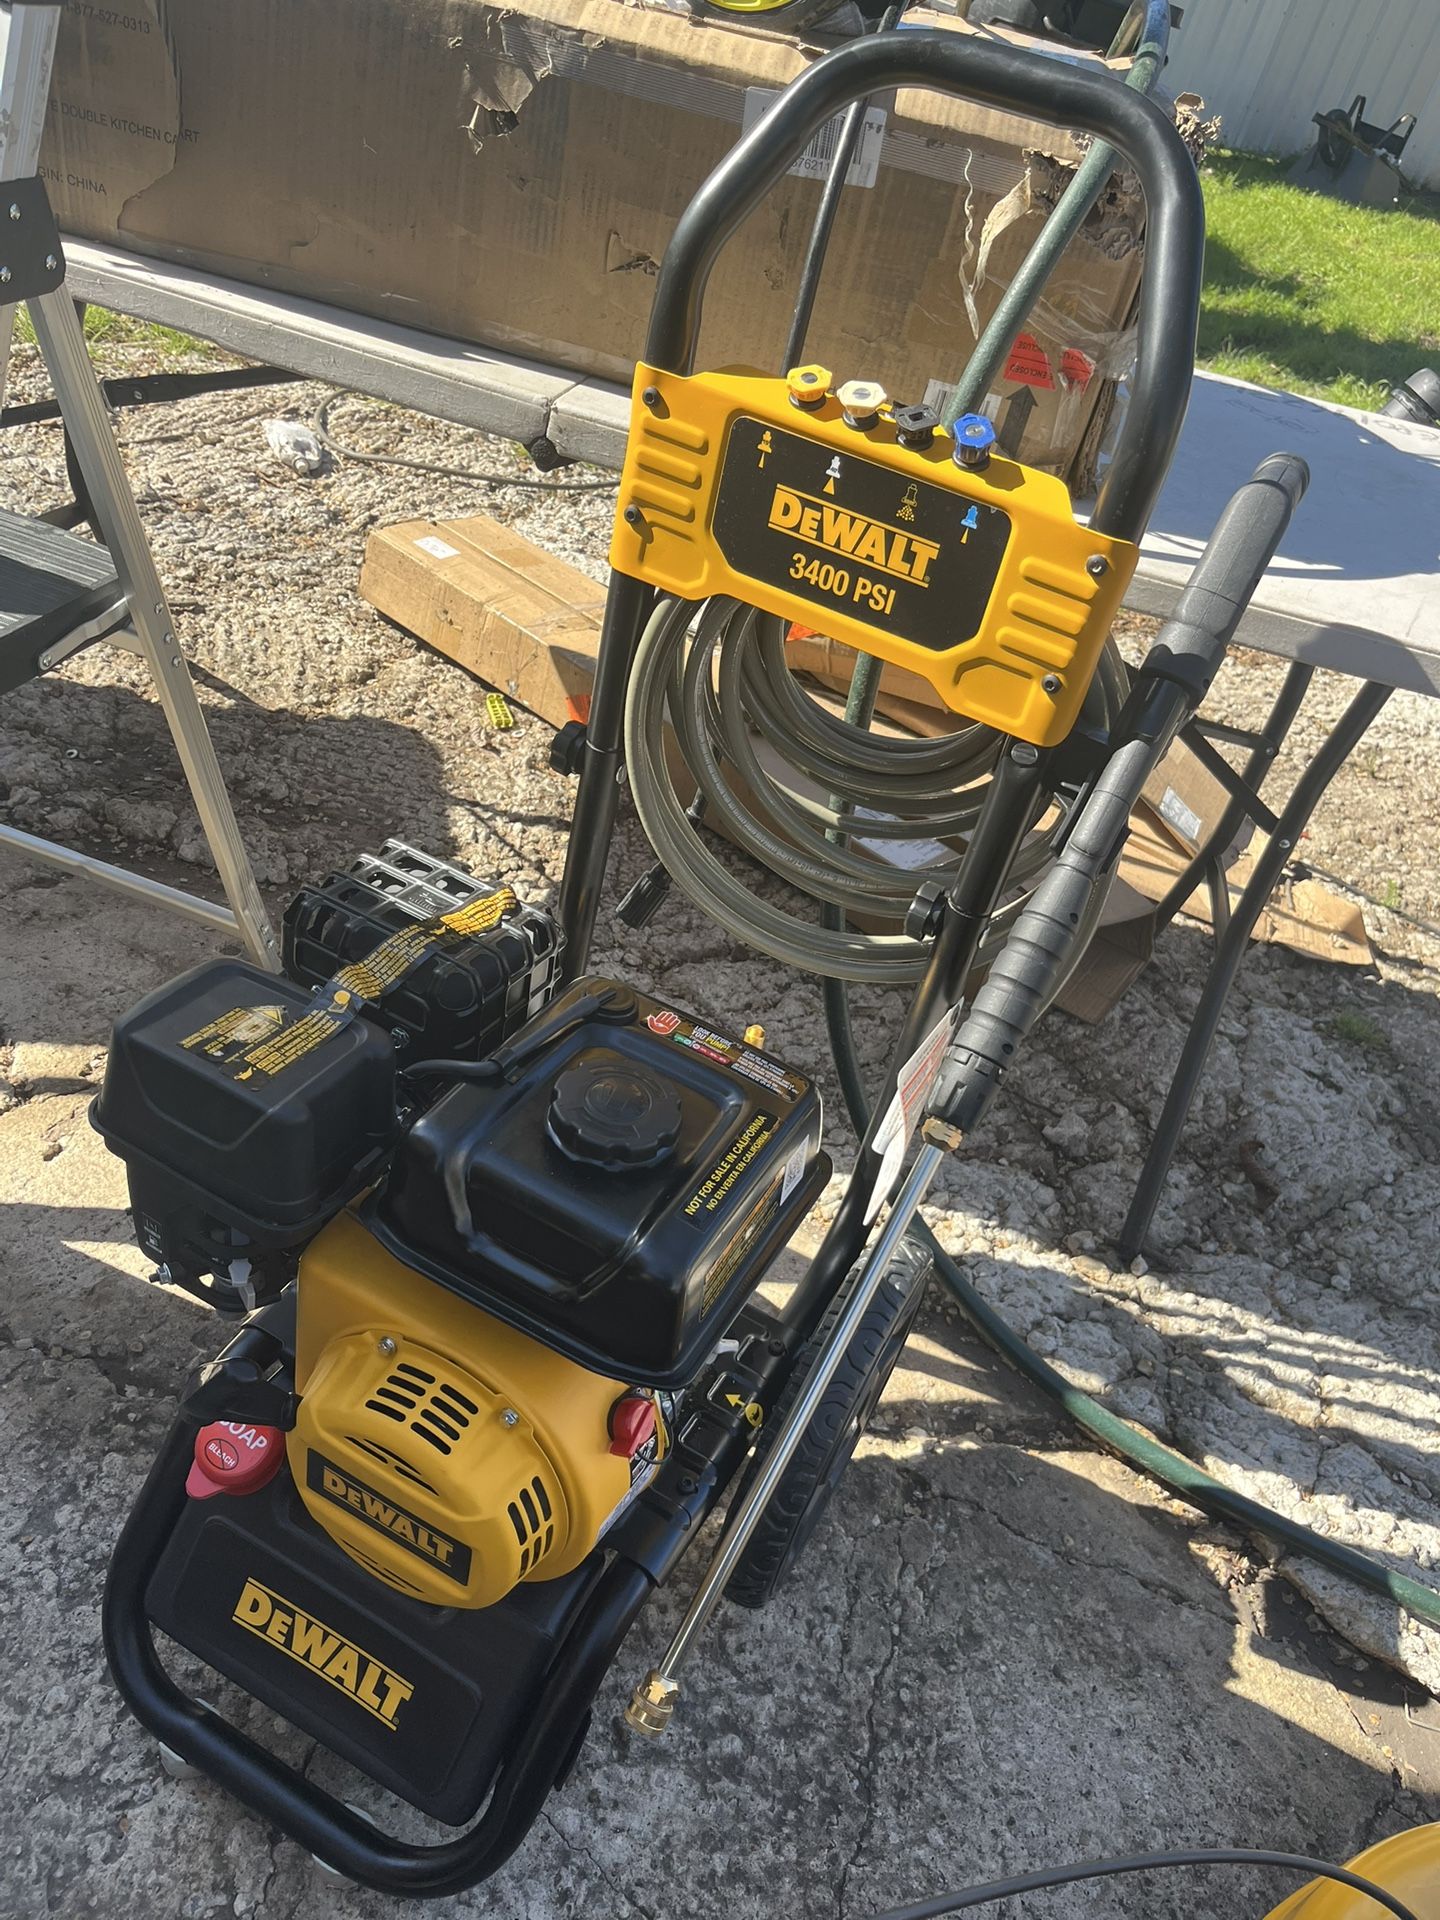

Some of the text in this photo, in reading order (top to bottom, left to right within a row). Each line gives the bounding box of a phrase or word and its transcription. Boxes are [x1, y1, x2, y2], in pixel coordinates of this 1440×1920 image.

[61, 102, 108, 126] DOUBLE
[111, 116, 161, 141] KITCHEN
[38, 166, 107, 196] GIN: CHINA
[789, 552, 897, 616] 3400 PSI
[684, 1114, 768, 1216] NOT FOR SALE IN CALIFORNIA
[705, 1130, 771, 1212] NO EN VENTA EN CALIFORNIA
[208, 1442, 237, 1467] BLEACH
[323, 1468, 454, 1563] DEWALT
